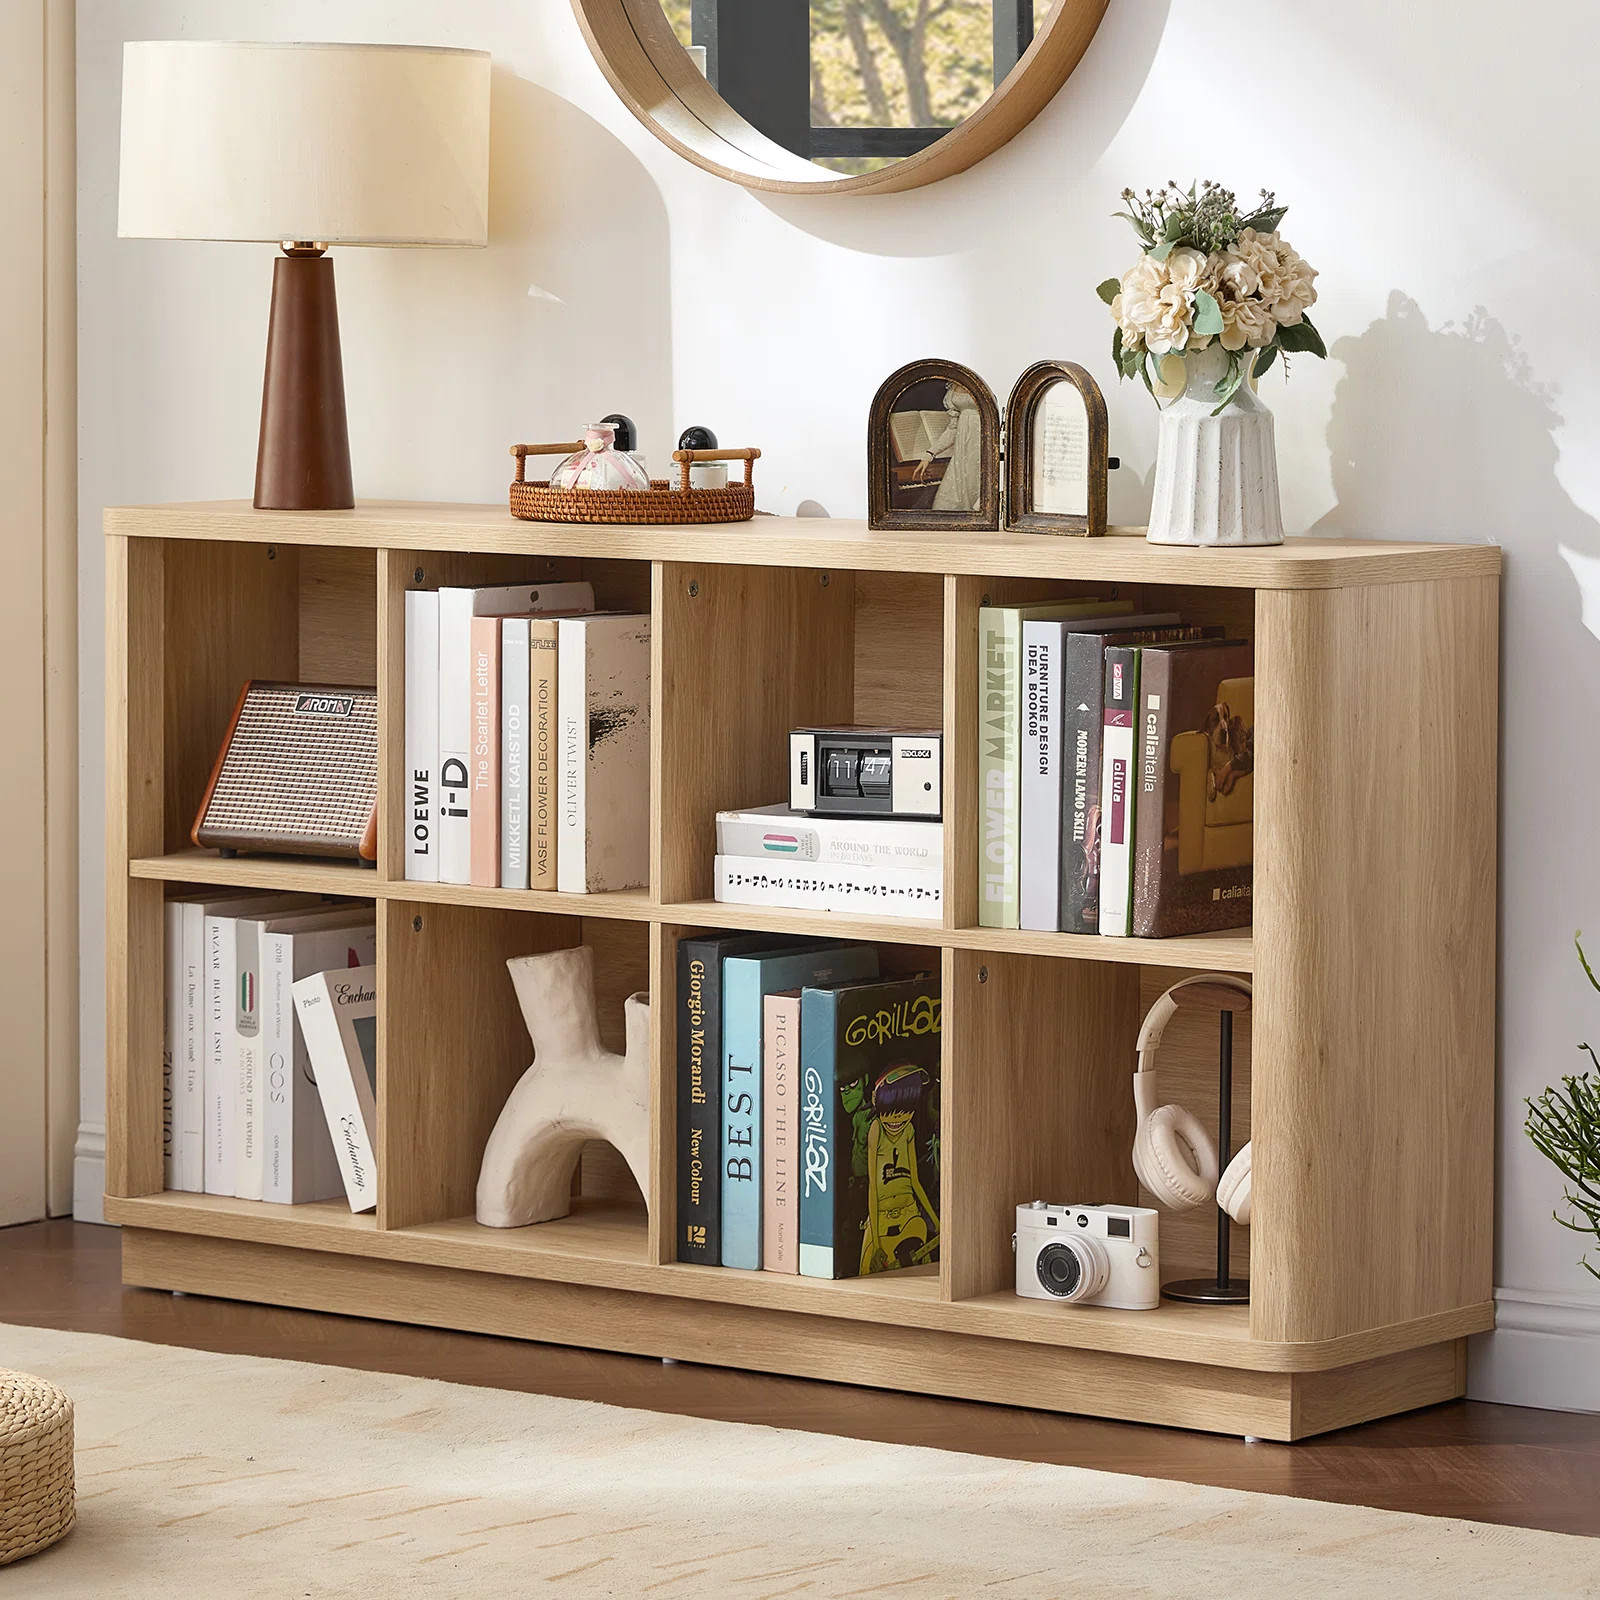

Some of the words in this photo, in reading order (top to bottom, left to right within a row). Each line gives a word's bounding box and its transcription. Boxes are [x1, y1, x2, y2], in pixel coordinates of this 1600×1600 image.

[475, 651, 488, 696] Letter
[1028, 645, 1037, 676] IDEA
[1038, 645, 1049, 723] FURNITURE
[299, 698, 345, 713] AROMA
[986, 631, 1015, 762] MARKET
[1028, 683, 1037, 736] BOOK08
[475, 700, 488, 756] Scarlet
[508, 704, 520, 788] KARSTOD
[538, 679, 548, 771] DECORATION
[568, 716, 577, 766] TWIST
[833, 760, 850, 779] 11
[865, 757, 889, 775] 47
[1039, 725, 1049, 776] DESIGN
[1076, 730, 1088, 778] MODERN
[1144, 713, 1158, 793] caliaitalia
[475, 761, 488, 791] The
[567, 769, 577, 827] OLIVER
[1113, 762, 1125, 802] olivia
[414, 769, 428, 855] LOEWE
[538, 777, 547, 836] FLOWER
[1073, 812, 1085, 842] SKILL
[538, 841, 547, 876] VASE
[830, 841, 869, 853] AROUND
[873, 844, 891, 855] THE
[895, 846, 928, 858] WORLD
[985, 768, 1013, 904] FLOWER
[188, 965, 196, 977] La
[212, 926, 220, 969] BAZAAR
[188, 983, 196, 1008] Dame
[687, 960, 706, 1027] Giorgio
[269, 1051, 285, 1103] COS
[690, 1029, 706, 1104] Morandi
[776, 1013, 786, 1097] PICASSO
[690, 1129, 703, 1158] New
[727, 1054, 754, 1183] BEST
[776, 1104, 786, 1146] THE
[690, 1159, 703, 1205] Colour
[776, 1158, 786, 1207] LINE
